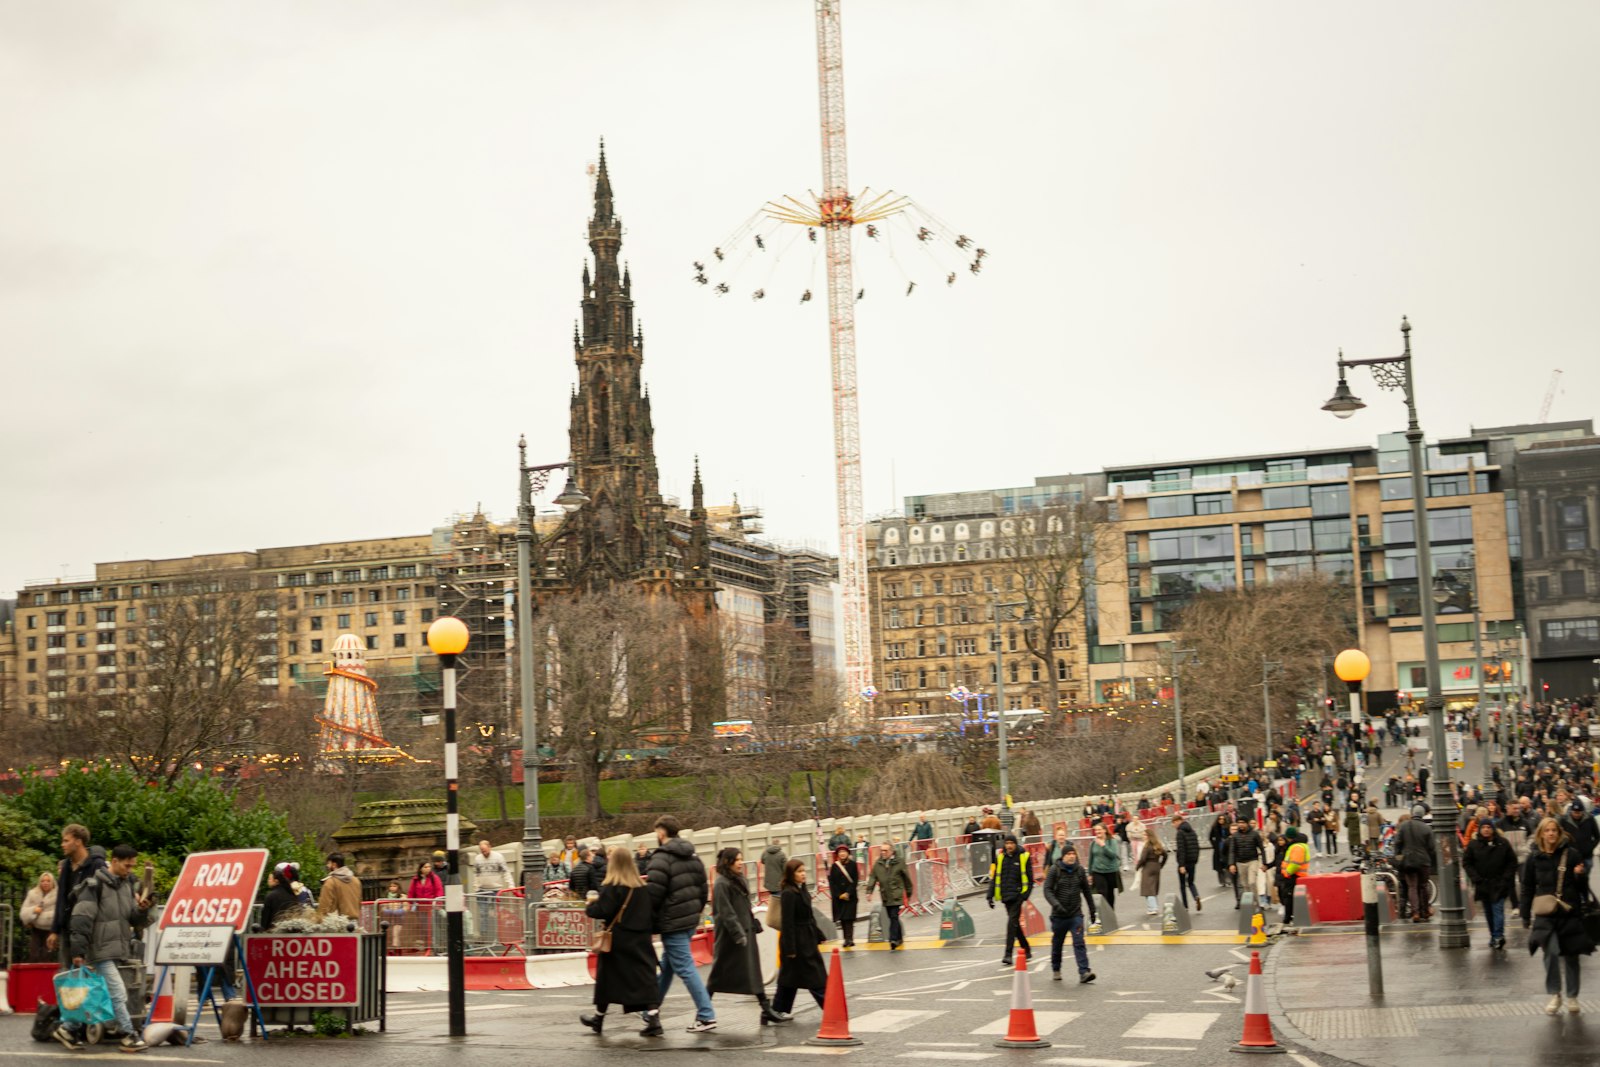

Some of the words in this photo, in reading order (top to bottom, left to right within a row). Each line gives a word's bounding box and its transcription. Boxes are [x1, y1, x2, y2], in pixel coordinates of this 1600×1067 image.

[192, 862, 244, 887] ROAD
[171, 898, 243, 924] CLOSED
[271, 939, 333, 957] ROAD
[263, 961, 340, 979] AHEAD
[257, 982, 346, 1001] CLOSED
